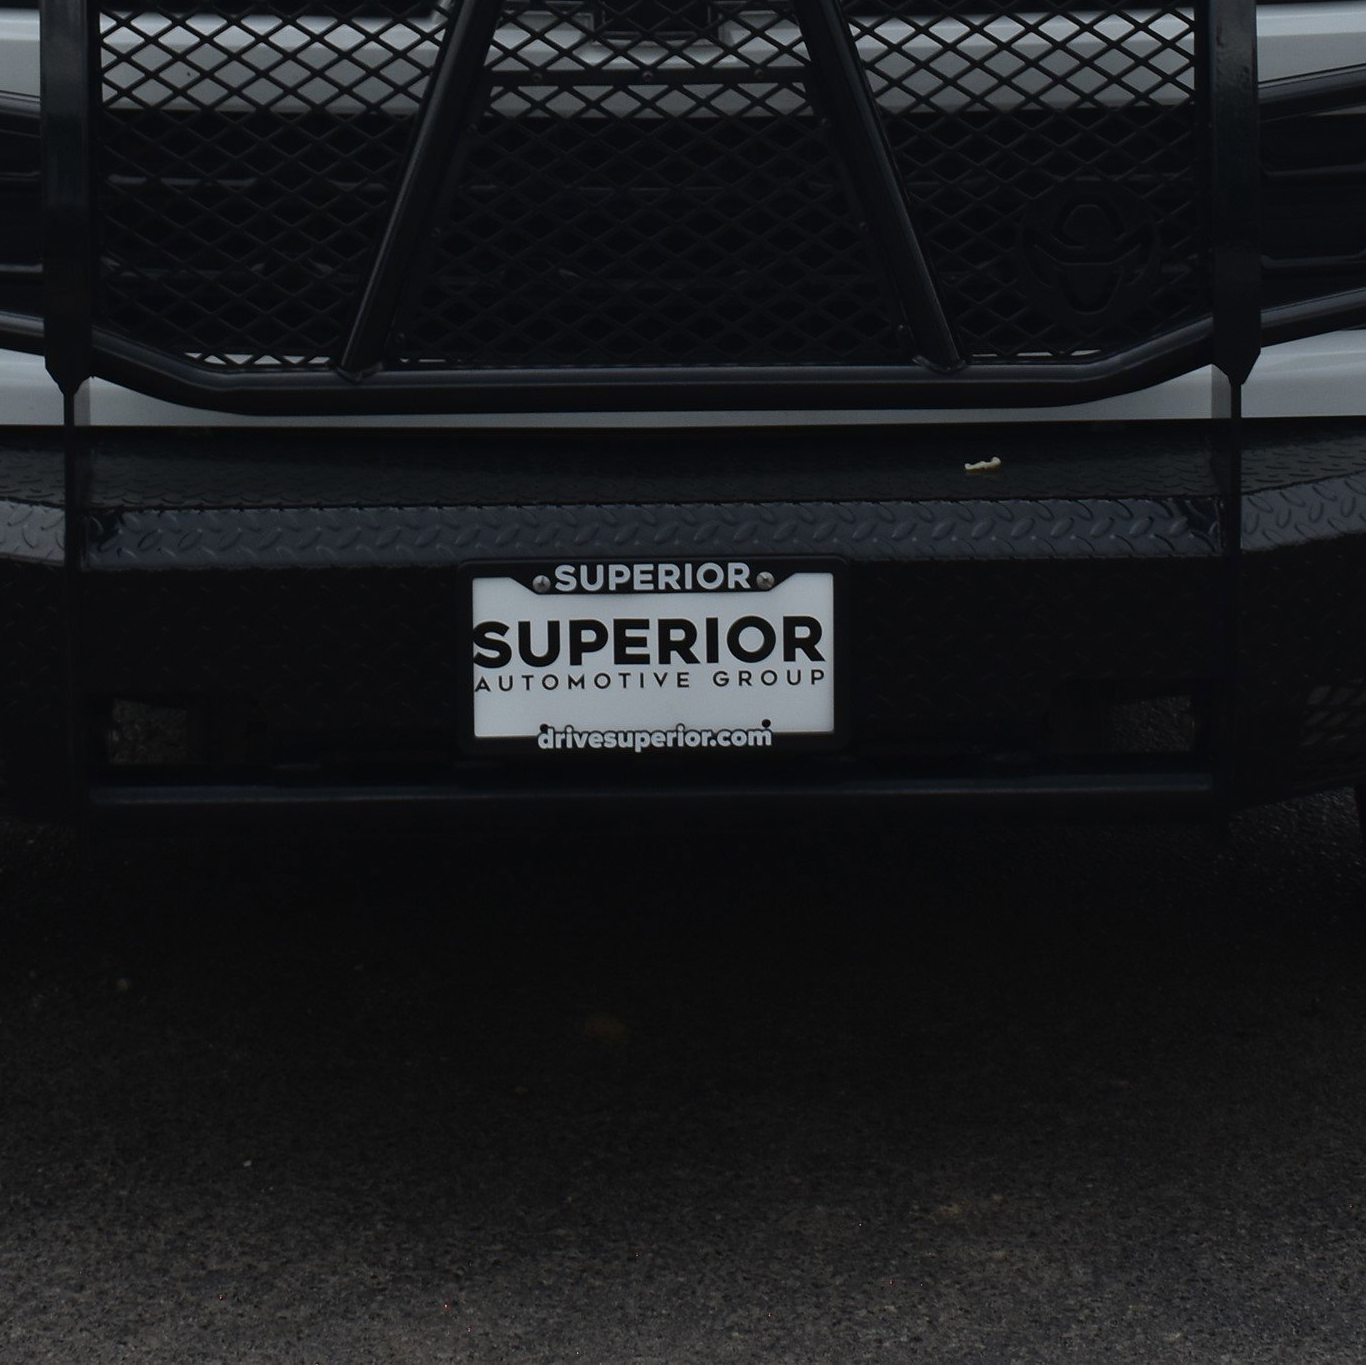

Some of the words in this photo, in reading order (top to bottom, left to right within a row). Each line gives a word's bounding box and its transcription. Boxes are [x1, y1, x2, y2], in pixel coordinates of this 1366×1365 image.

[554, 562, 751, 592] SUPERIOR
[473, 615, 826, 668] SUPERIOR
[474, 671, 691, 693] AUTOMOTIVE
[713, 669, 826, 687] GROUP
[537, 724, 773, 753] drivesuperior.com
